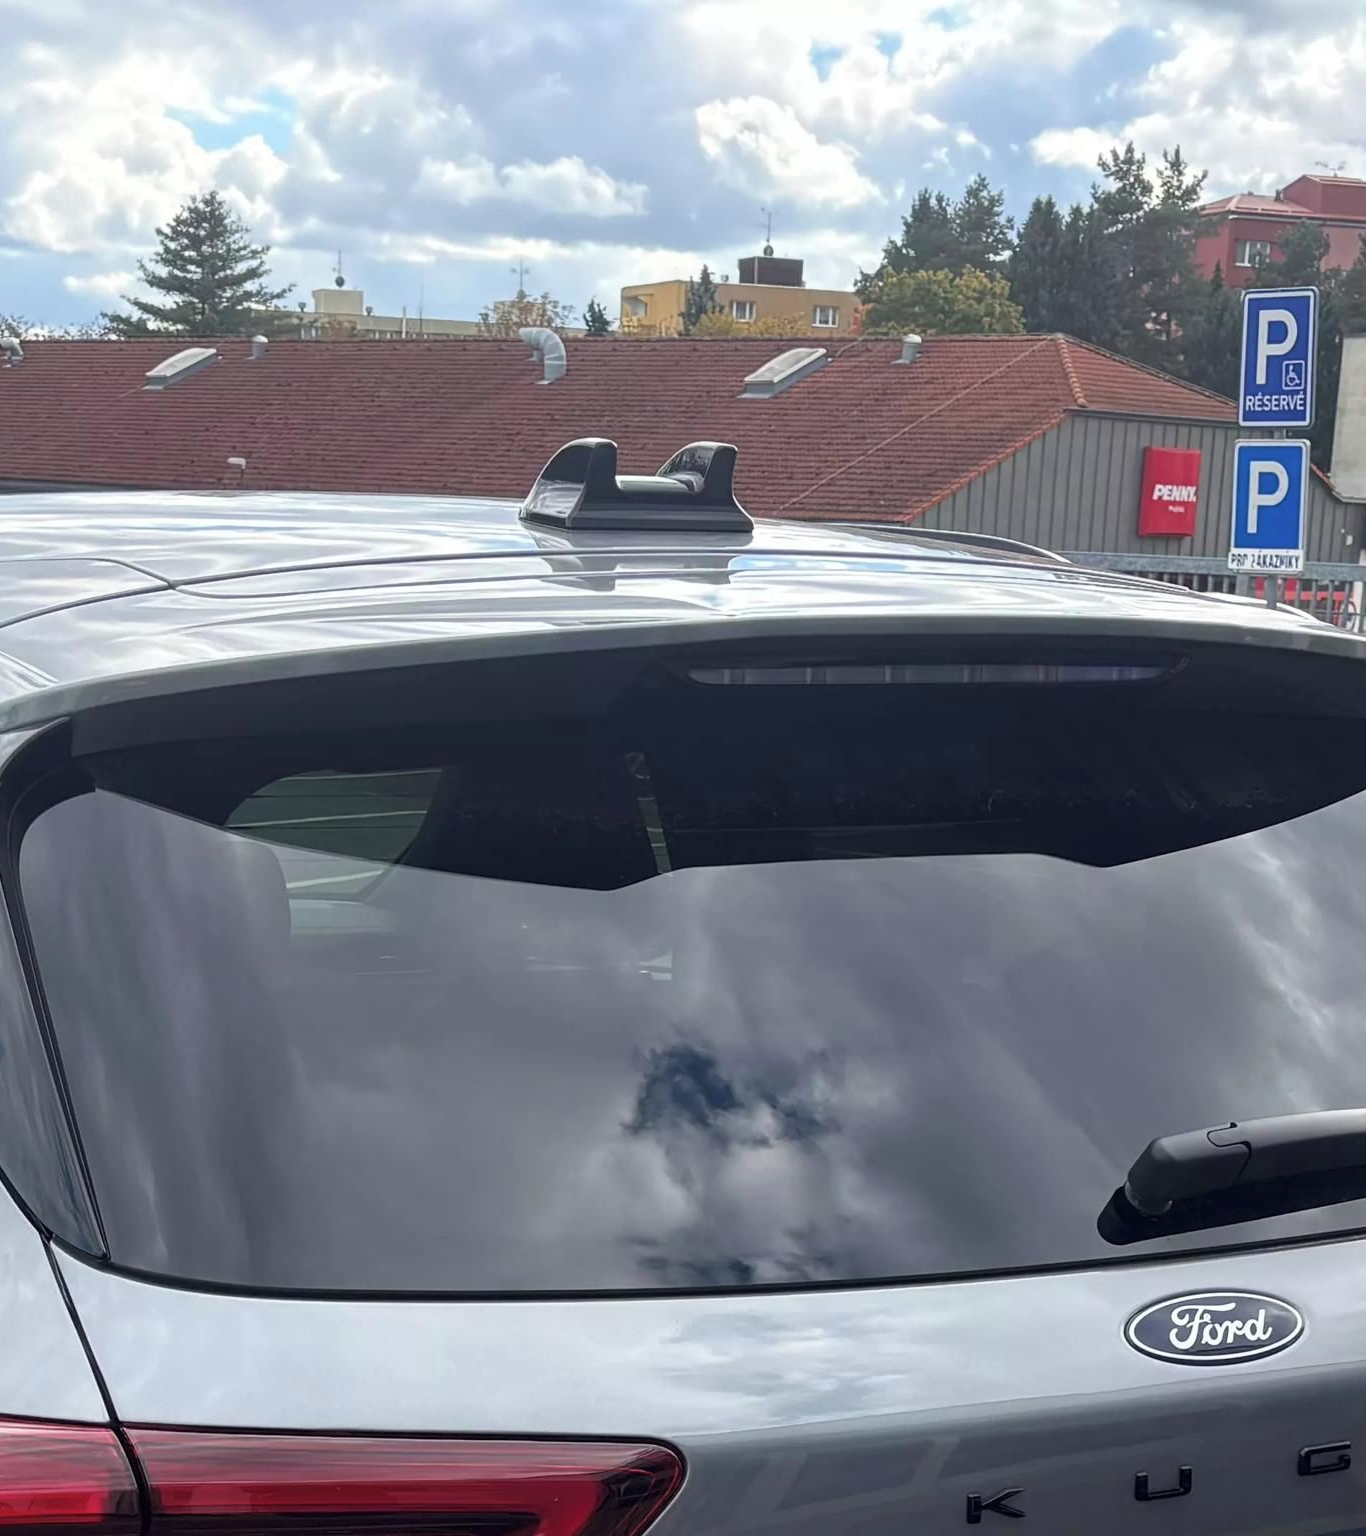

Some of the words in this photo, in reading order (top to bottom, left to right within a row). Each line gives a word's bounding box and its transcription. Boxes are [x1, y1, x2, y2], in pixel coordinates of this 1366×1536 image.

[1256, 309, 1299, 385] P
[1245, 391, 1305, 411] RÉSERVÉ
[1247, 460, 1289, 534] P
